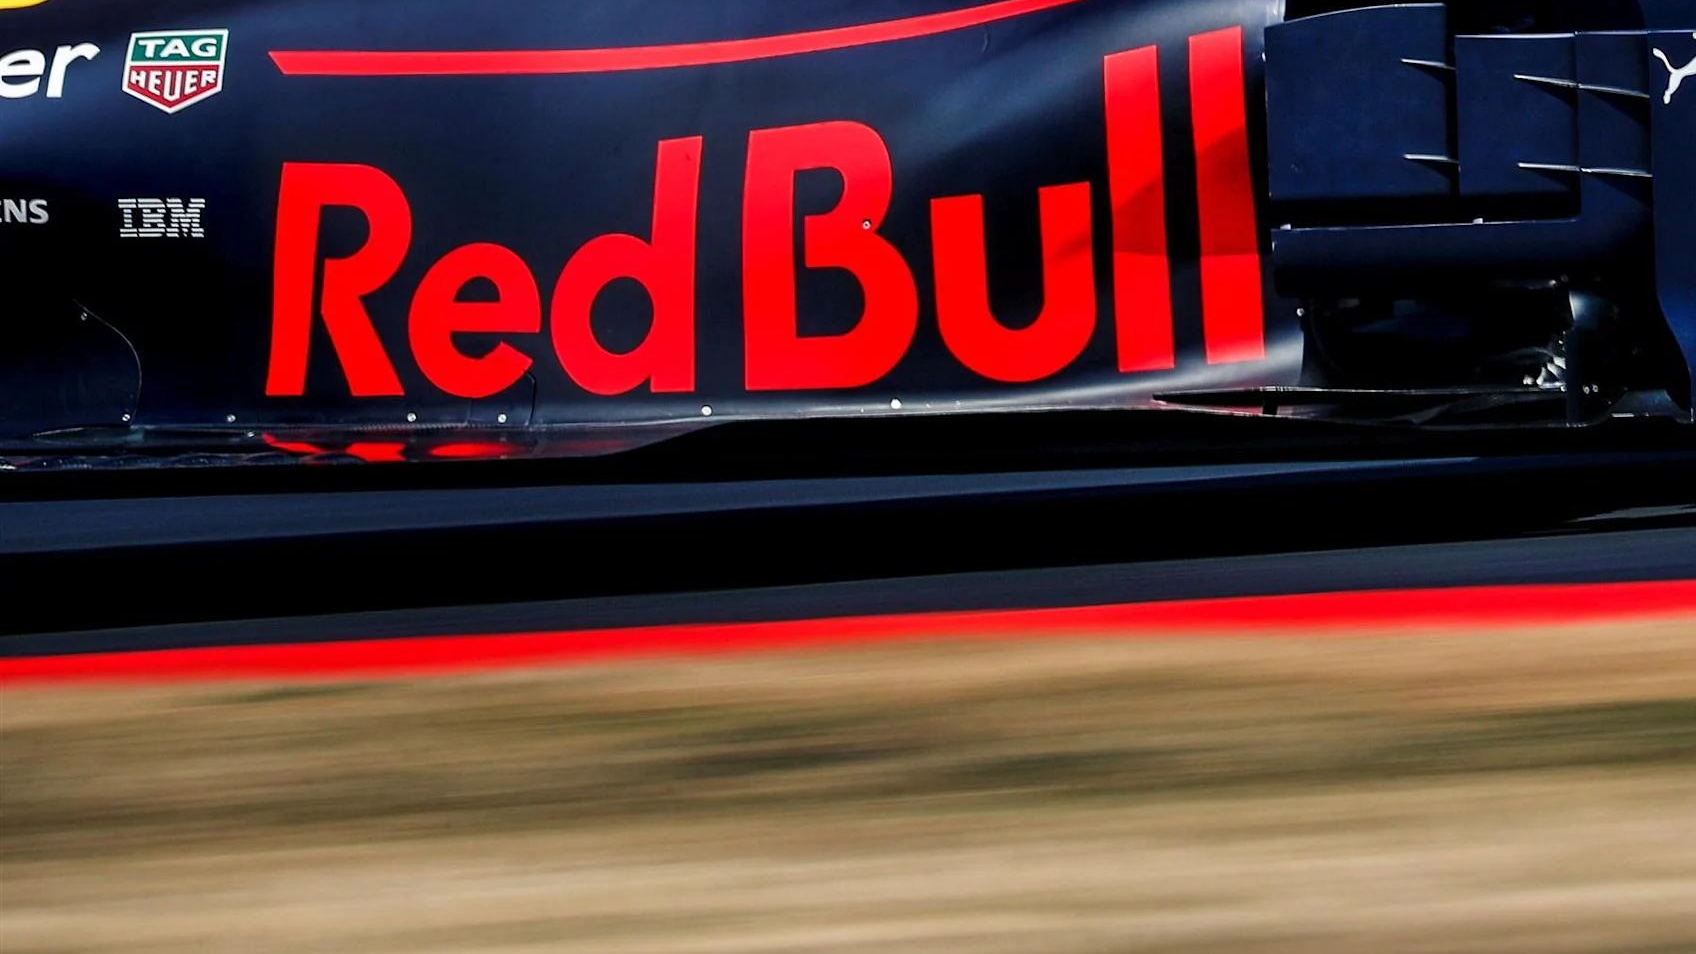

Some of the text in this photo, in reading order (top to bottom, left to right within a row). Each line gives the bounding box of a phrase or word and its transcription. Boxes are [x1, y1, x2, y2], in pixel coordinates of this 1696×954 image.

[138, 38, 217, 58] TAG
[130, 69, 216, 102] HEUER
[0, 198, 49, 224] NS
[118, 198, 205, 237] IBM
[266, 25, 1266, 397] Red Bull
